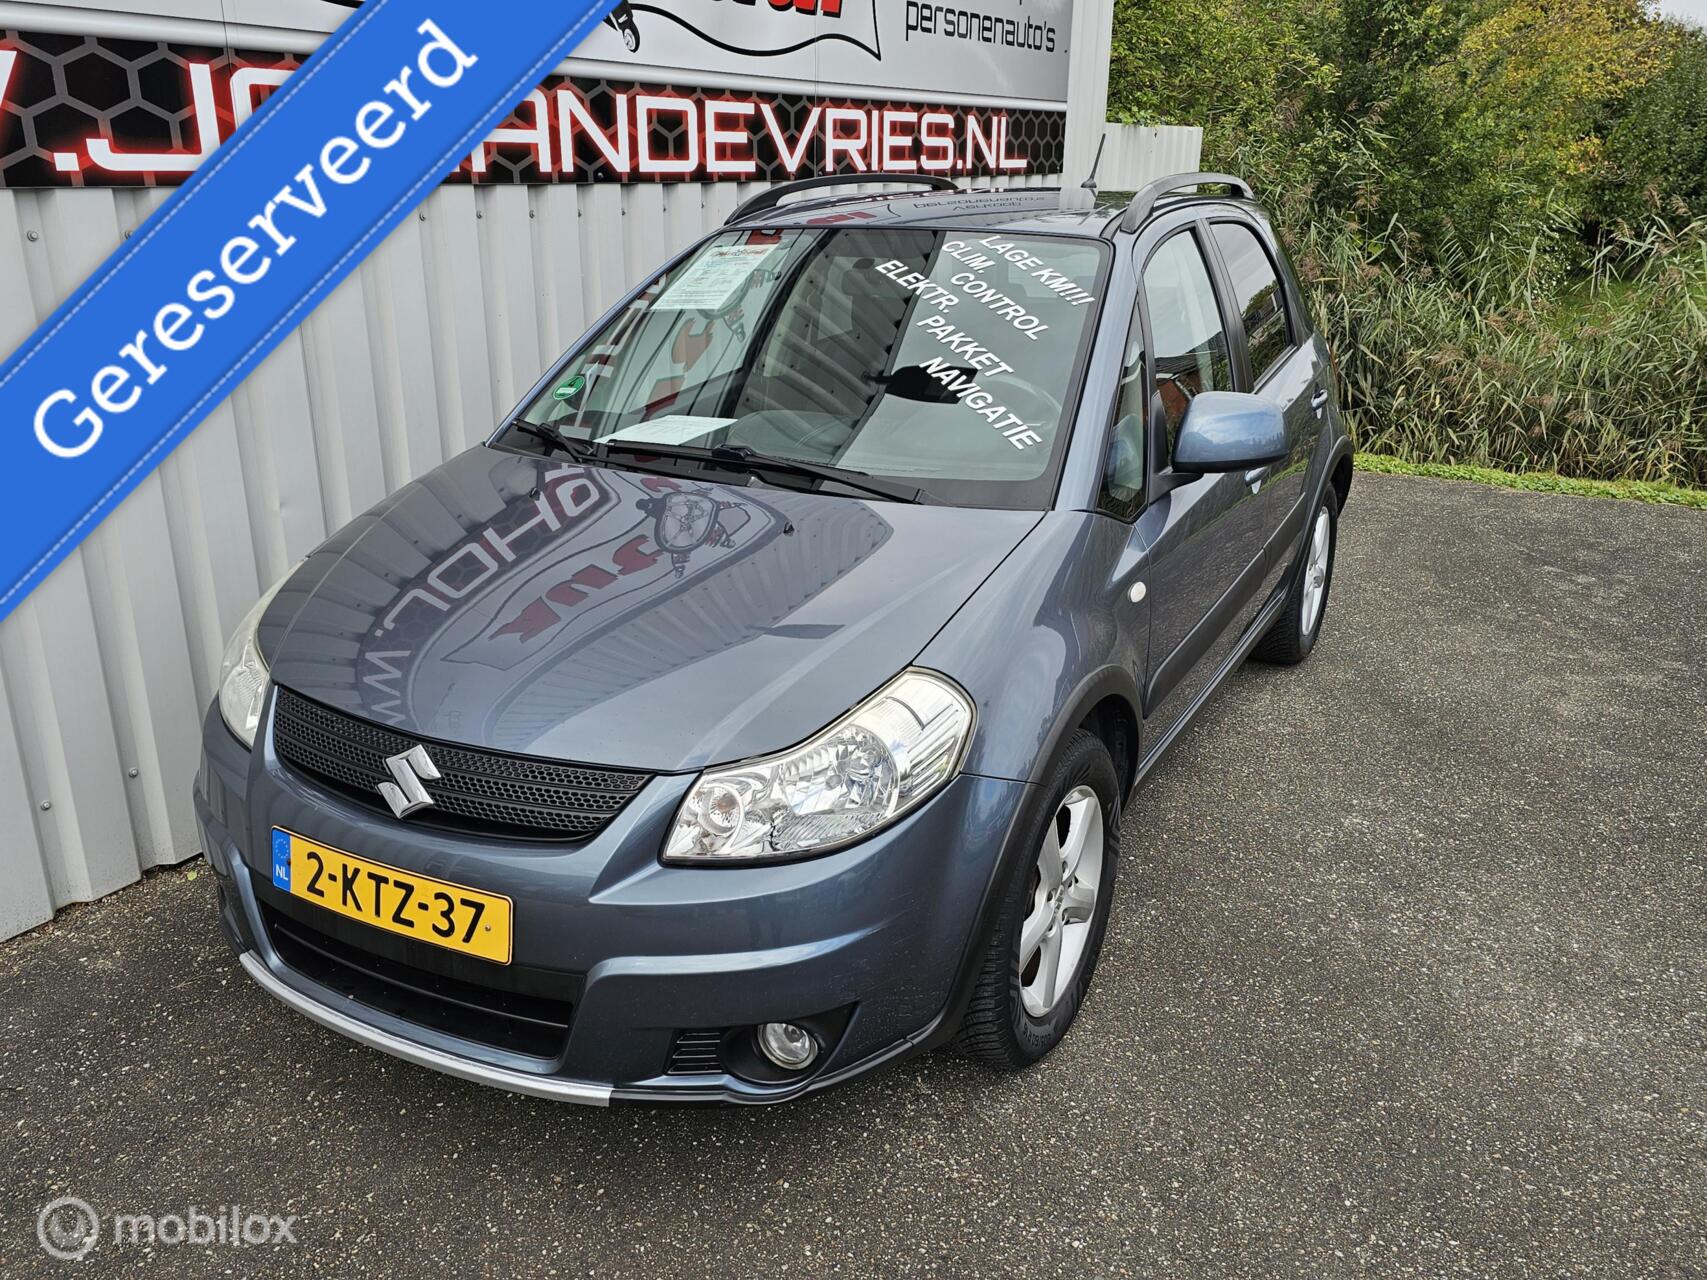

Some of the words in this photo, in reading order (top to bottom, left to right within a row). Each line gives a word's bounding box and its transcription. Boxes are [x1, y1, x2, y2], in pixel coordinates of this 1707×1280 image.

[905, 2, 1056, 53] personenauto's
[875, 259, 960, 314] ELEKTR.
[942, 240, 996, 274] CLIM.
[979, 235, 1044, 271] LAGE
[1031, 268, 1096, 306] KM!!!
[950, 272, 1049, 341] CONTROL
[916, 315, 1015, 377] PAKKET
[919, 356, 1043, 450] NAVIGATIE
[275, 863, 289, 881] NL
[306, 851, 485, 944] 2-KTZ-37
